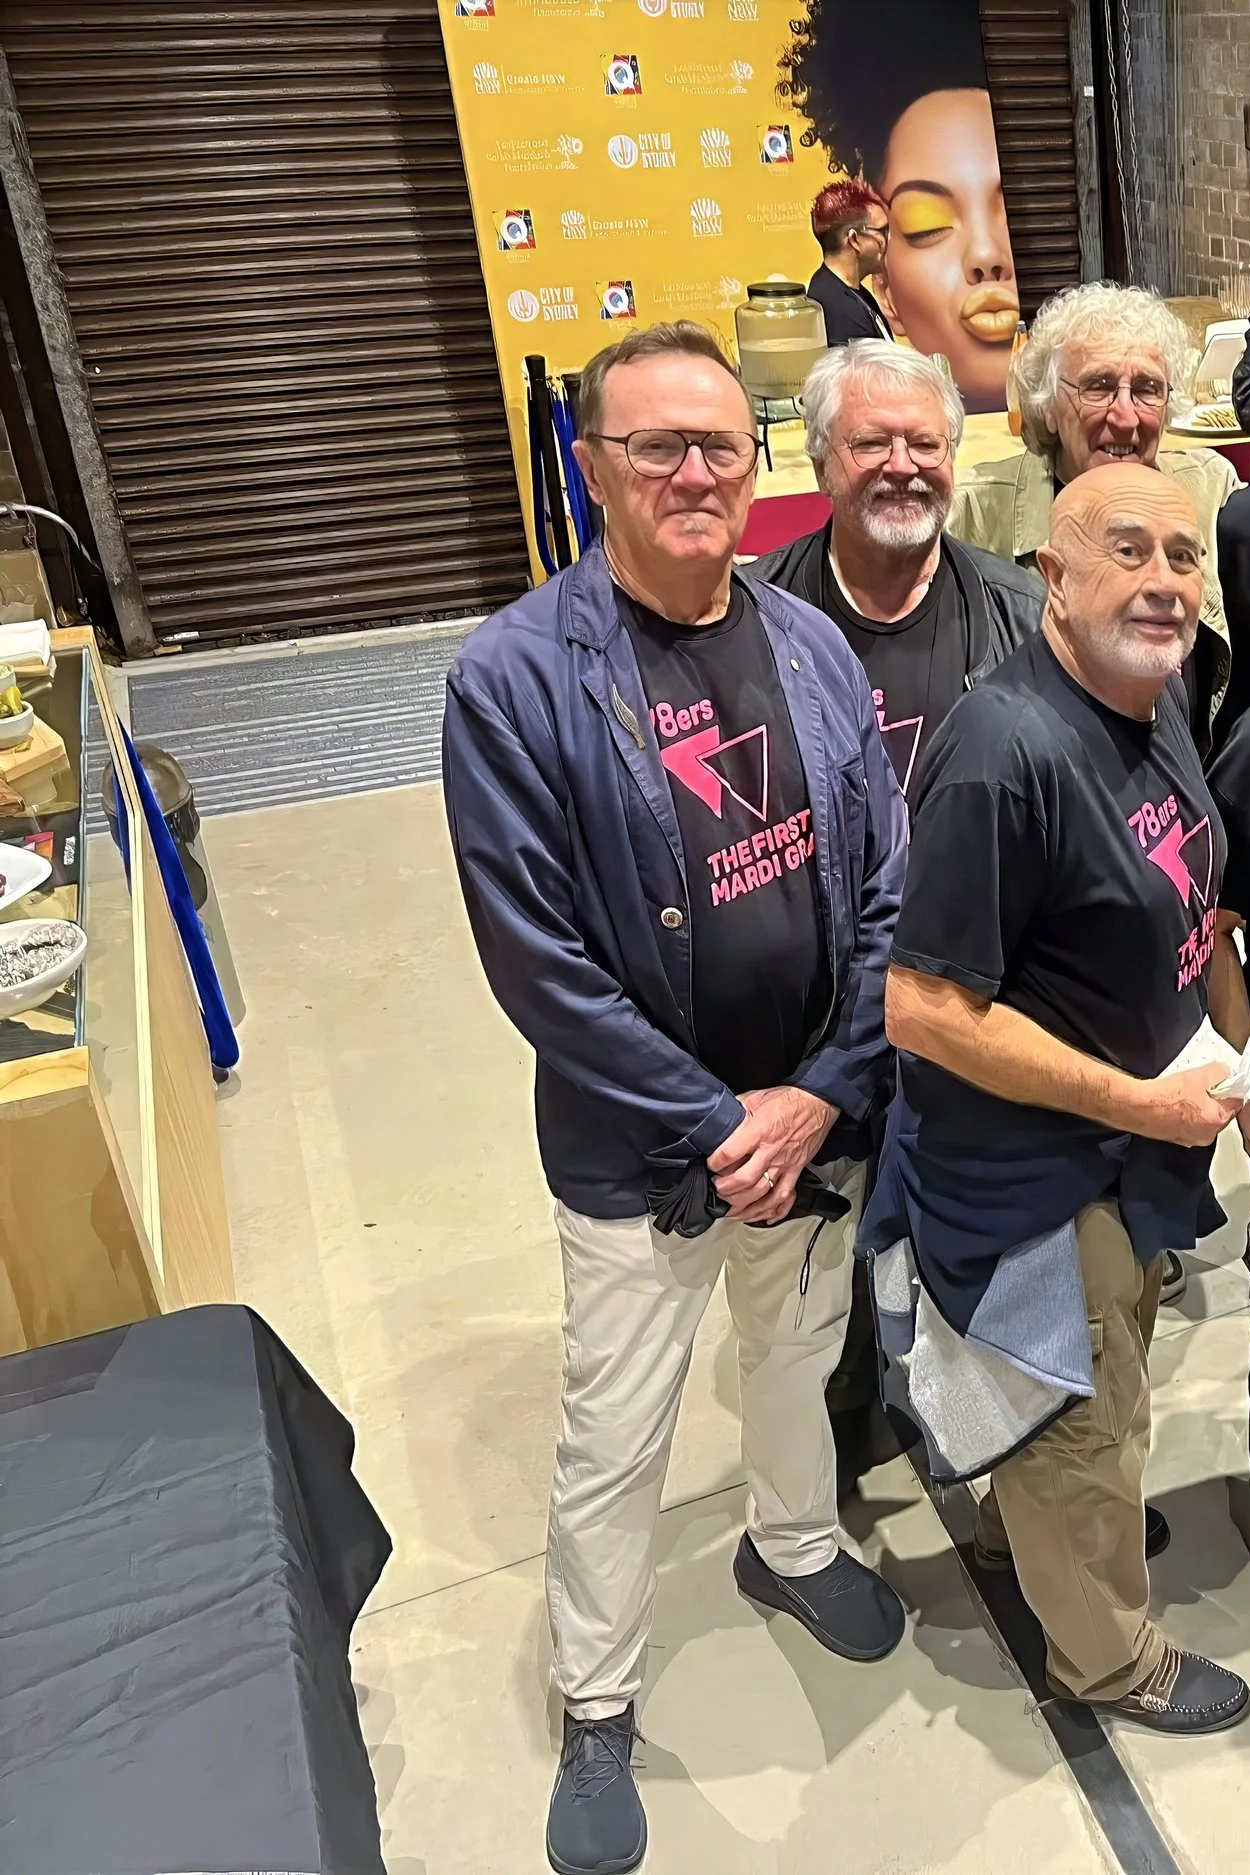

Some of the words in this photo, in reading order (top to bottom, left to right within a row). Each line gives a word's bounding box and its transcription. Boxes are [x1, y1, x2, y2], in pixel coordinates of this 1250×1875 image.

[707, 838, 752, 879] THE
[750, 808, 811, 860] FIRST
[1127, 794, 1178, 848] 78ers
[710, 853, 782, 907] MARDI
[784, 832, 815, 872] GRA
